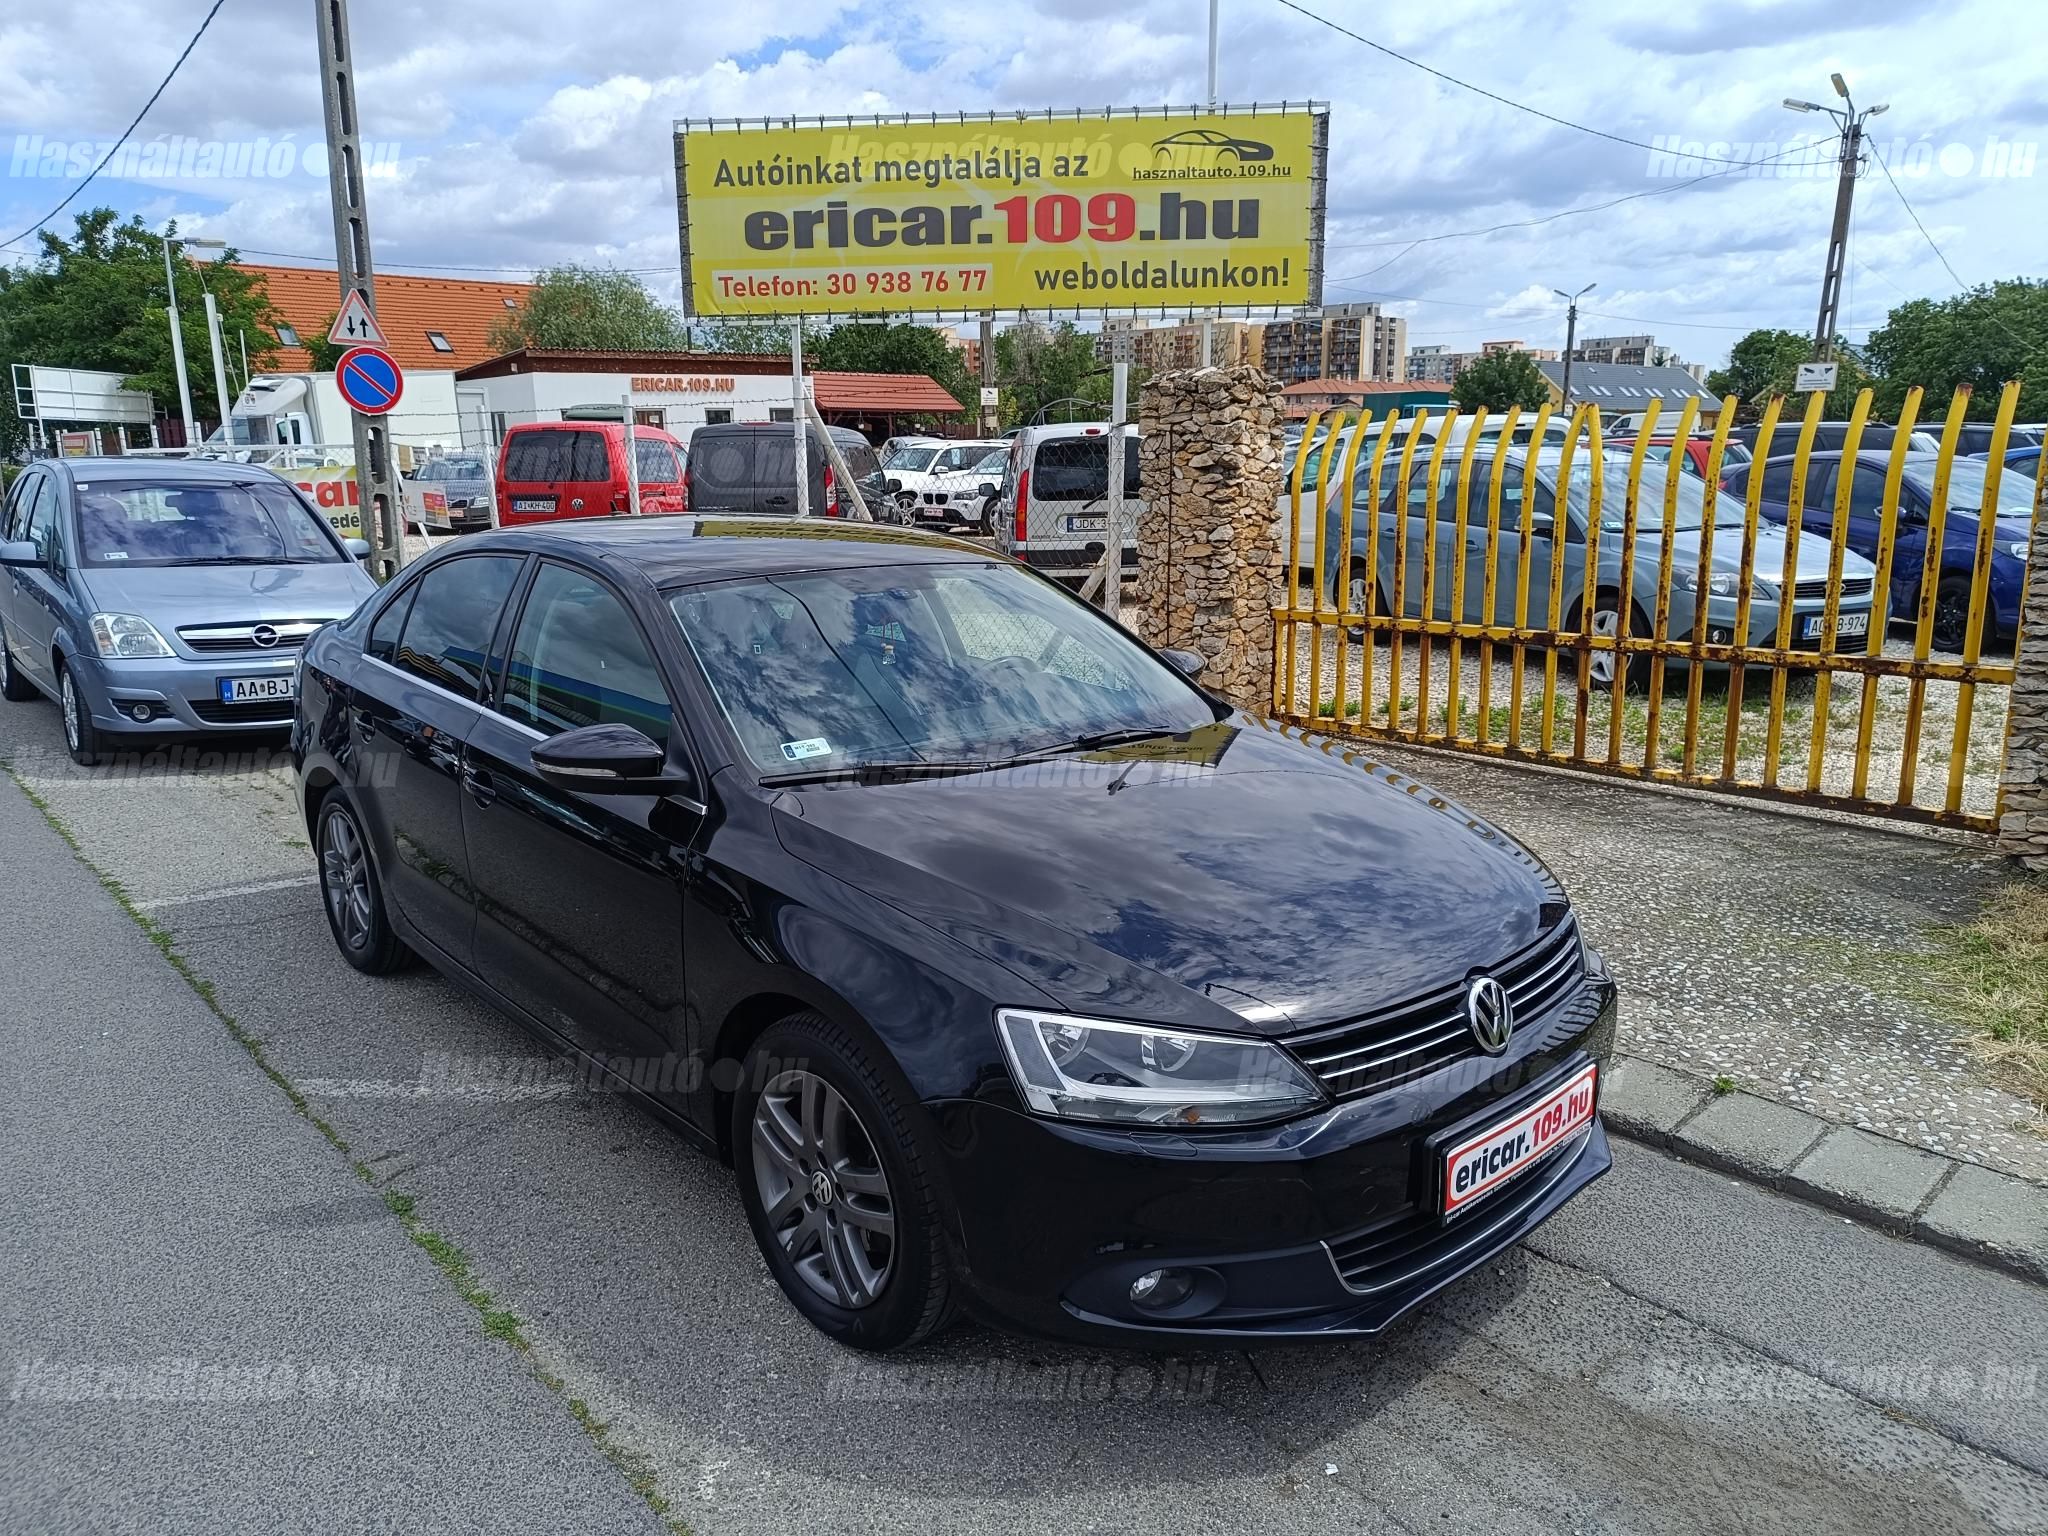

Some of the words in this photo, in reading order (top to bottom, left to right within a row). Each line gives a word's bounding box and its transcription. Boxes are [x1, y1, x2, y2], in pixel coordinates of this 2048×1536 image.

[714, 153, 863, 188] Autóinkat
[874, 149, 1041, 189] megtalálja
[1053, 153, 1089, 178] az
[1133, 163, 1292, 180] hasznaltauto.109.hu
[744, 192, 1260, 251] ericar.109.hu
[718, 275, 819, 298] Telefon:
[826, 273, 856, 295] 30
[866, 272, 912, 294] 938
[920, 271, 950, 293] 76
[958, 270, 987, 292] 77
[1034, 257, 1291, 292] weboldalunkon!
[631, 377, 735, 392] ERICAR.109.HU
[236, 682, 259, 698] AA
[1455, 1087, 1590, 1194] ericar.109.hu
